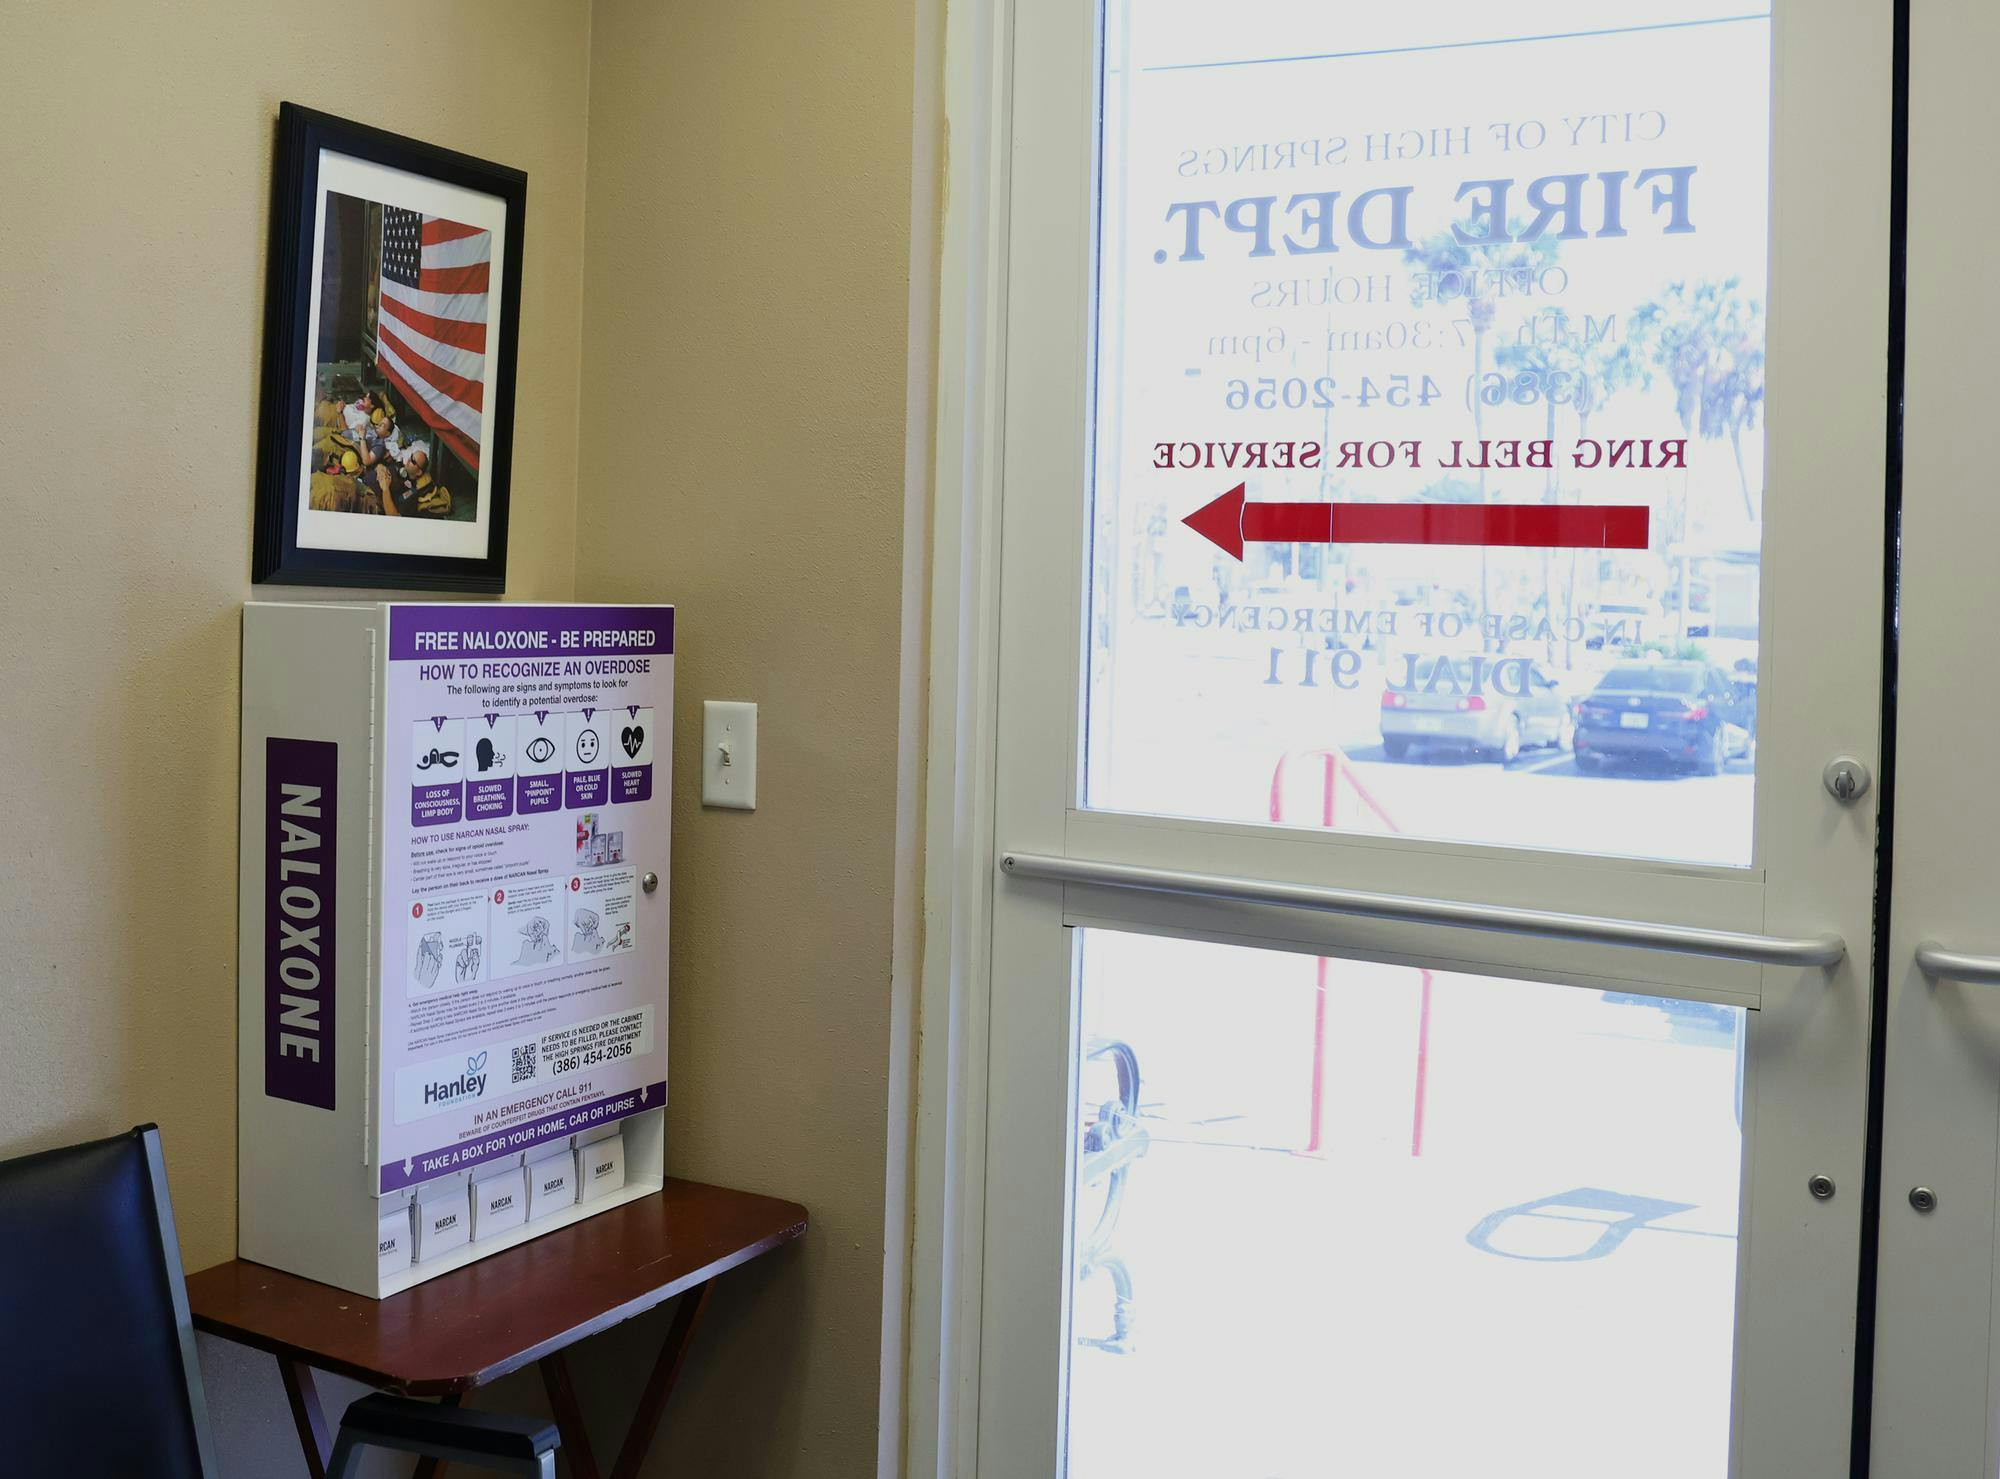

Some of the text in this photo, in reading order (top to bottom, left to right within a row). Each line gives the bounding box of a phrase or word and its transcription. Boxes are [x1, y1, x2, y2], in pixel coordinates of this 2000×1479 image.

[415, 631, 459, 651] FREE
[462, 630, 549, 650] NALOXONE
[560, 630, 580, 648] BE
[583, 630, 656, 648] PREPARED
[420, 659, 650, 681] HOW TO RECOGNIZE AN OVERDOSE
[447, 679, 629, 695] The following are signs and symptoms to look for
[482, 694, 598, 708] to identify a potential overdose:
[573, 776, 587, 784] PALE,
[621, 770, 642, 779] SLOWED
[478, 784, 502, 794] SLOWED
[529, 779, 549, 788] SMALL,
[575, 783, 598, 792] OR COLD
[623, 778, 640, 787] HEART
[426, 789, 450, 799] LOSS OF
[473, 793, 506, 803] BREATHING,
[580, 792, 593, 800] SKIN
[625, 787, 638, 795] RATE
[414, 798, 461, 809] CONSCIOUSNESS,
[476, 802, 503, 812] CHOKING
[530, 797, 549, 806] PUPILS
[421, 808, 454, 818] LIMP BODY
[411, 823, 530, 845] HOW TO USE NARCAN NASAL SPRAY:
[280, 783, 322, 1063] NALOXONE
[542, 1012, 643, 1044] IF SERVICE IS NEEDED OR THE CABINET
[542, 1021, 643, 1054] NEEDS TO BE FILLED, PLEASE CONTACT
[543, 1030, 642, 1062] THE HIGH SPRINGS FIRE DEPARTMENT
[552, 1041, 632, 1076] (386) 454-2056
[424, 1073, 487, 1105] Hanley
[474, 1082, 592, 1125] IN AN EMERGENCY CALL 911
[458, 1090, 606, 1140] BEWARE OF COUNTERFEIT DRUGS THAT CONTAIN FENTANYL
[422, 1097, 635, 1173] TAKE A BOX FOR YOUR HOME, CAR OR PURSE
[595, 1161, 614, 1175] NARCAN
[543, 1177, 564, 1192] NARCAN
[490, 1195, 512, 1210] NARCAN
[434, 1214, 457, 1231] NARCAN
[379, 1238, 396, 1252] RCAN
